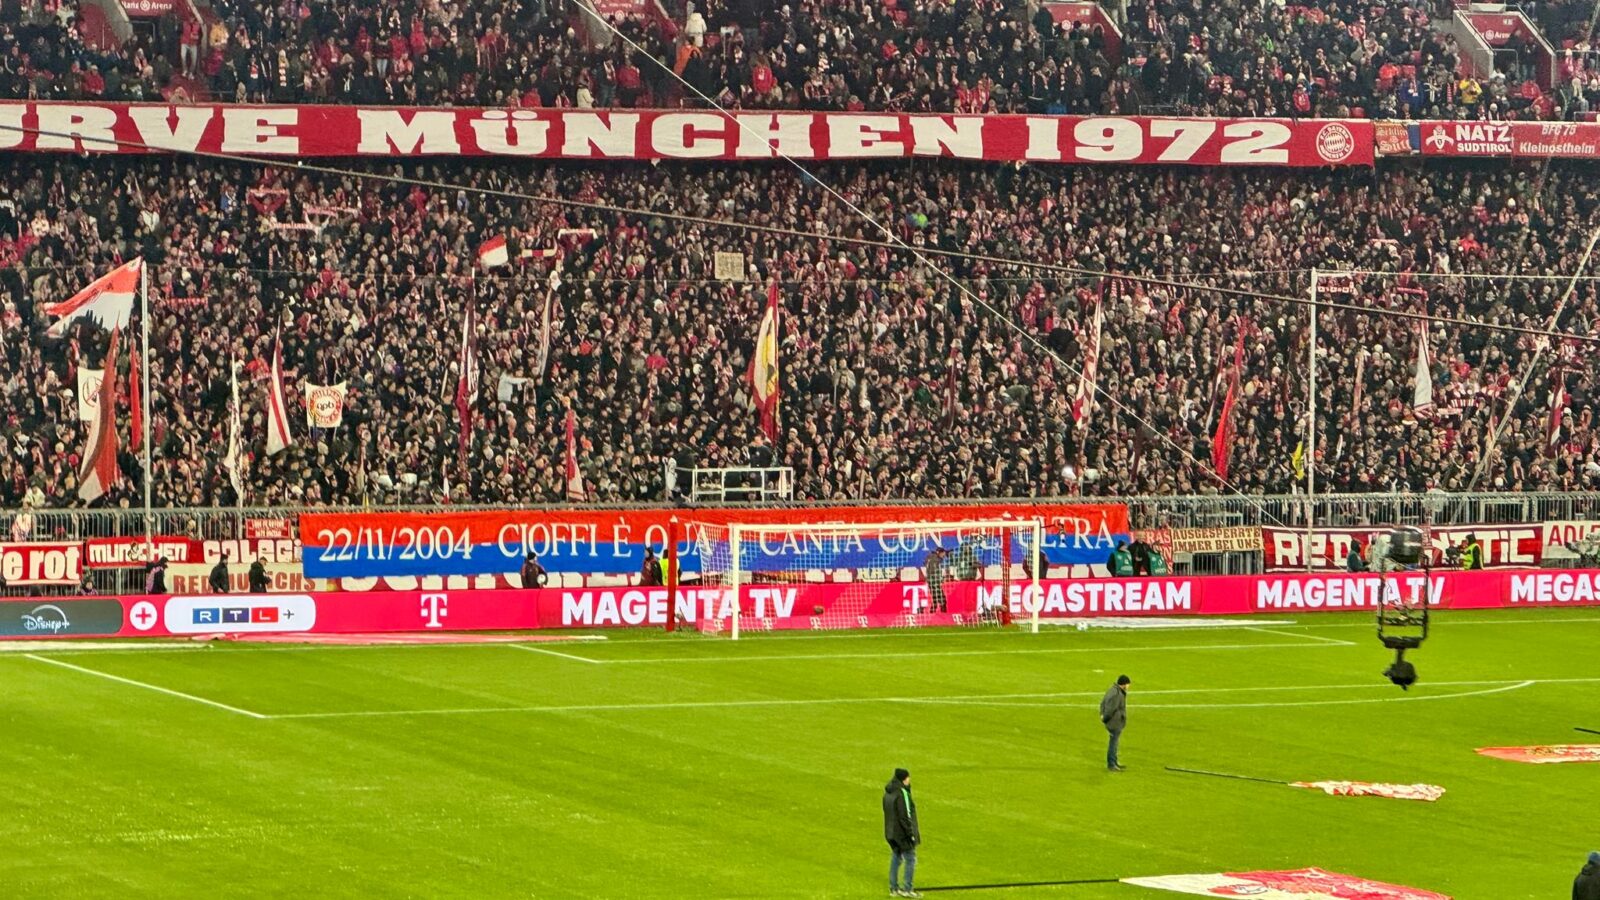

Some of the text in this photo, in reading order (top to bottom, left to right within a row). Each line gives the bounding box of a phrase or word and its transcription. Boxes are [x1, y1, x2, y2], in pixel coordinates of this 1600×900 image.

[0, 103, 299, 154] RVE
[1024, 116, 1291, 165] 1972
[1455, 124, 1511, 142] NATZ
[1519, 142, 1596, 154] Kleinostheim
[317, 525, 474, 562] 22/11/2004
[497, 521, 599, 558] CIOFFI
[612, 516, 633, 558] È
[1174, 538, 1260, 552] IMMER BEI UNS
[29, 546, 80, 580] rot
[561, 587, 798, 628] MAGENTA TV
[976, 580, 1191, 615] MEGASTREAM
[1256, 576, 1446, 609] MAGENTA TV
